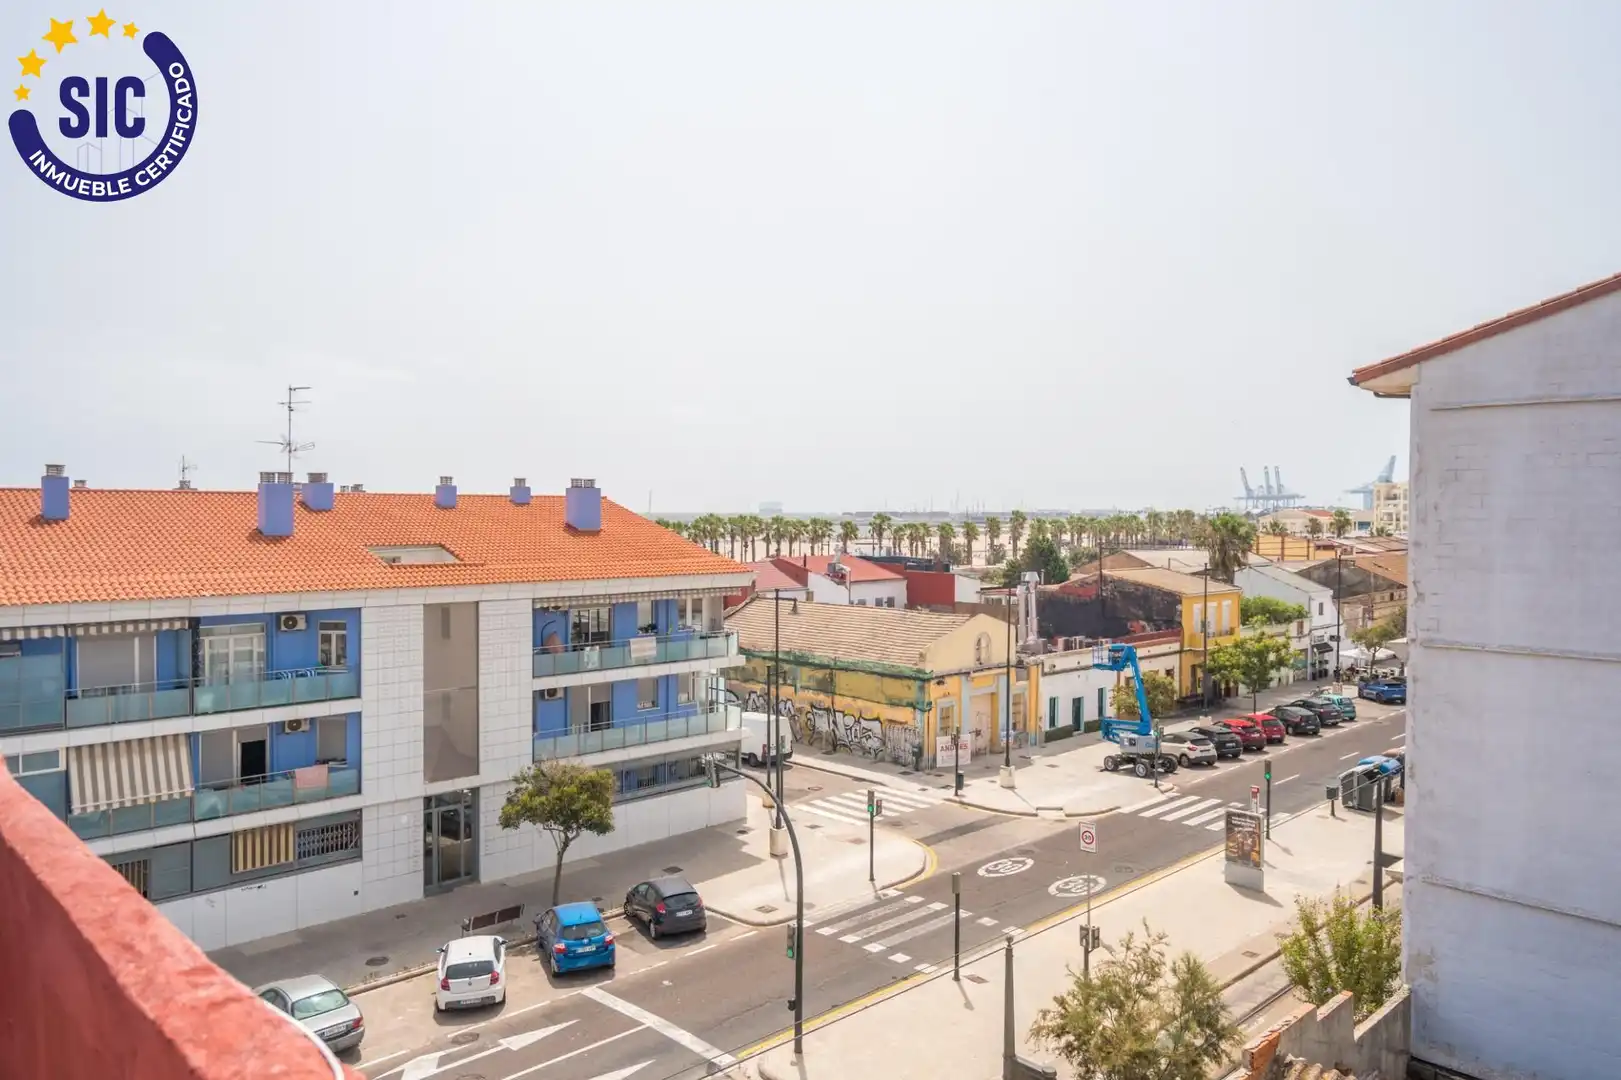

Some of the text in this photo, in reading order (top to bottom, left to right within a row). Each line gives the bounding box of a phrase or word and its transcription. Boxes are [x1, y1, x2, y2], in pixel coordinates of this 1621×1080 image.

[940, 742, 968, 752] ANDES
[988, 859, 1023, 873] 30
[1059, 879, 1095, 893] 30
